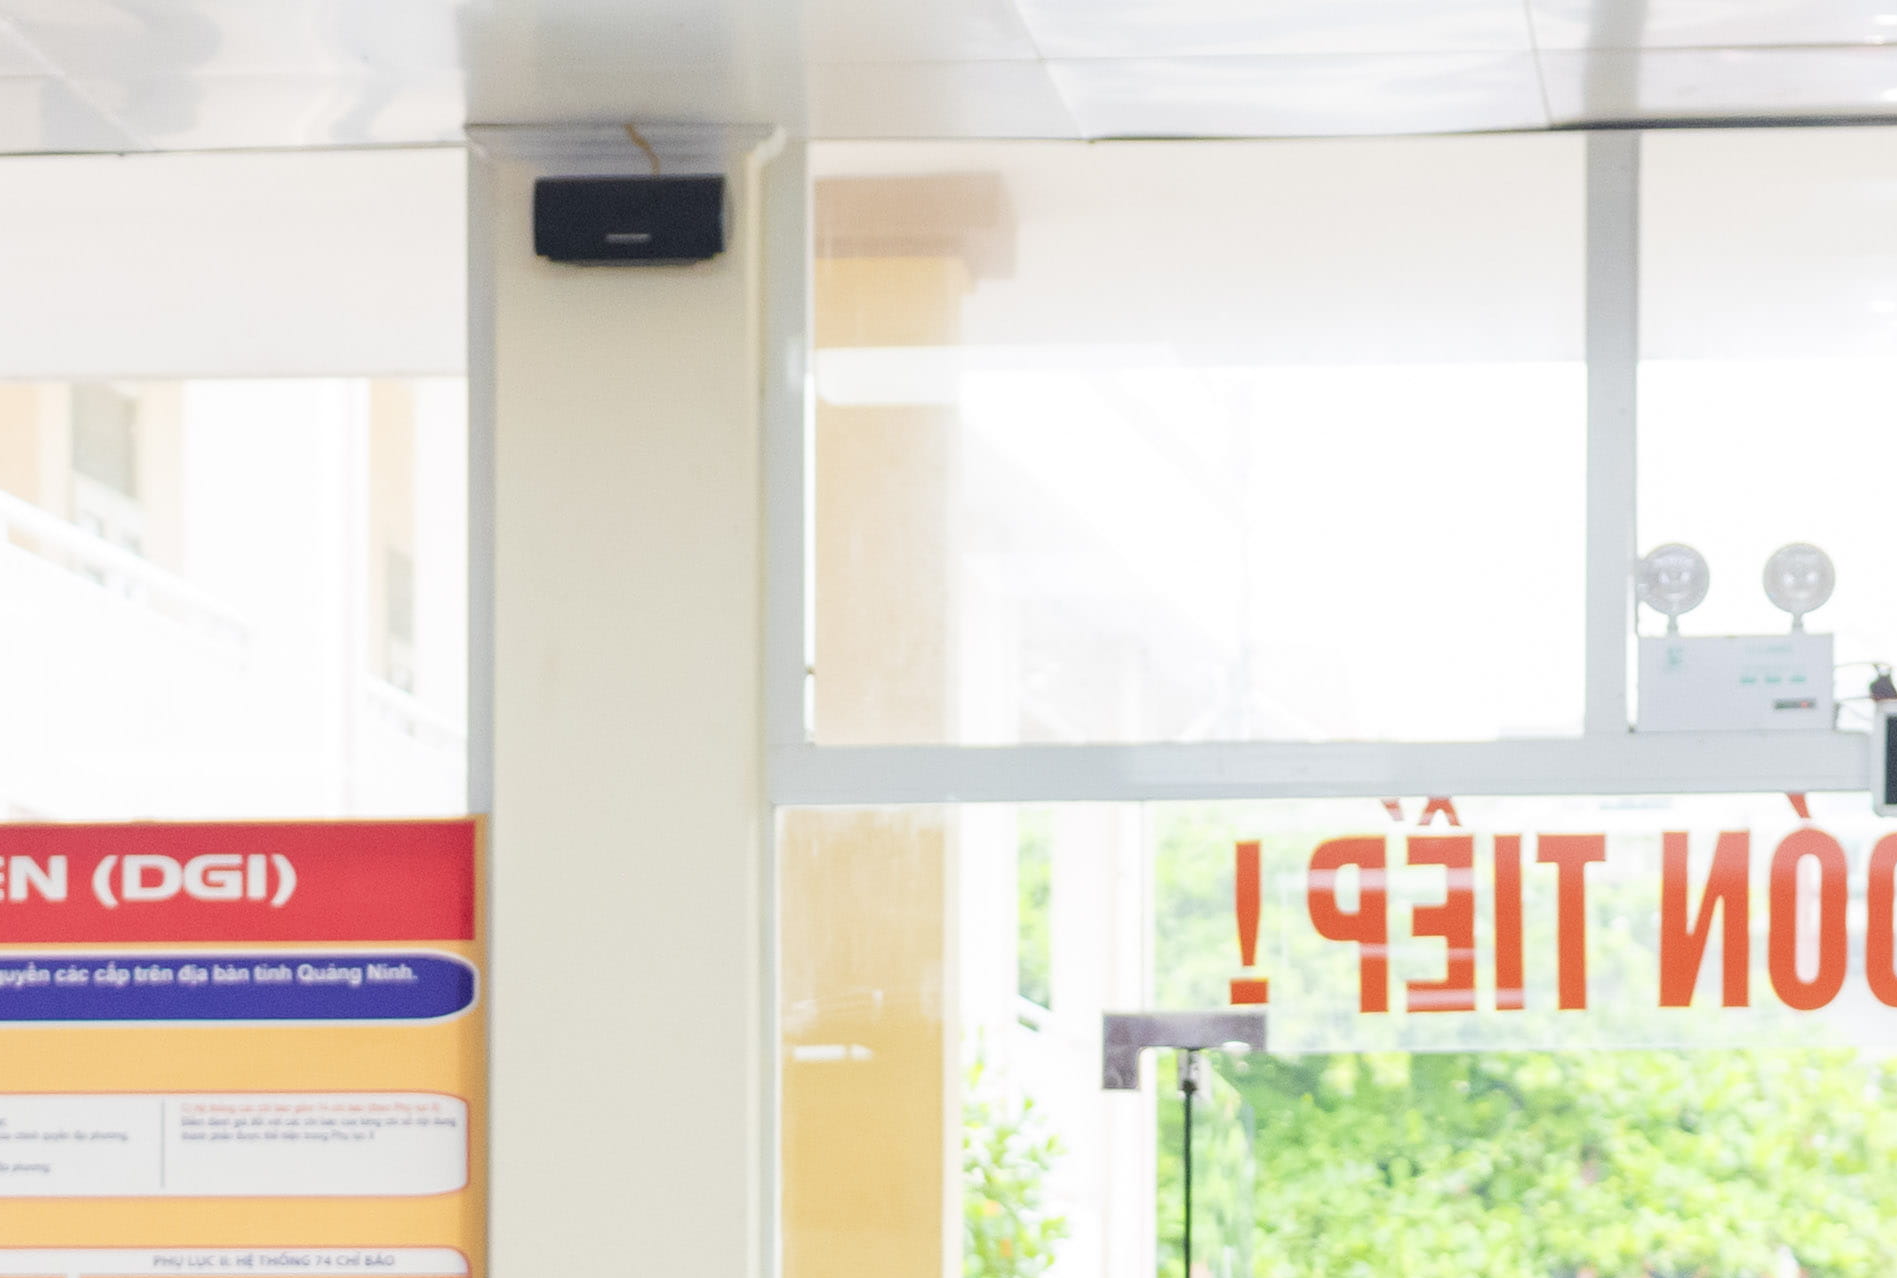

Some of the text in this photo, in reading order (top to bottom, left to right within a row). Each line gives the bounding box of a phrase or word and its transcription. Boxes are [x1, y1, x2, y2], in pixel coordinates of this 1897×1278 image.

[91, 854, 297, 909] (DGI)
[54, 966, 90, 987] các
[93, 962, 130, 990] cấp
[134, 966, 174, 987] trên
[177, 966, 208, 989] địa
[212, 965, 249, 986] bàn
[253, 965, 292, 986] tỉnh
[296, 965, 364, 989] Quảng
[367, 965, 419, 986] Ninh.
